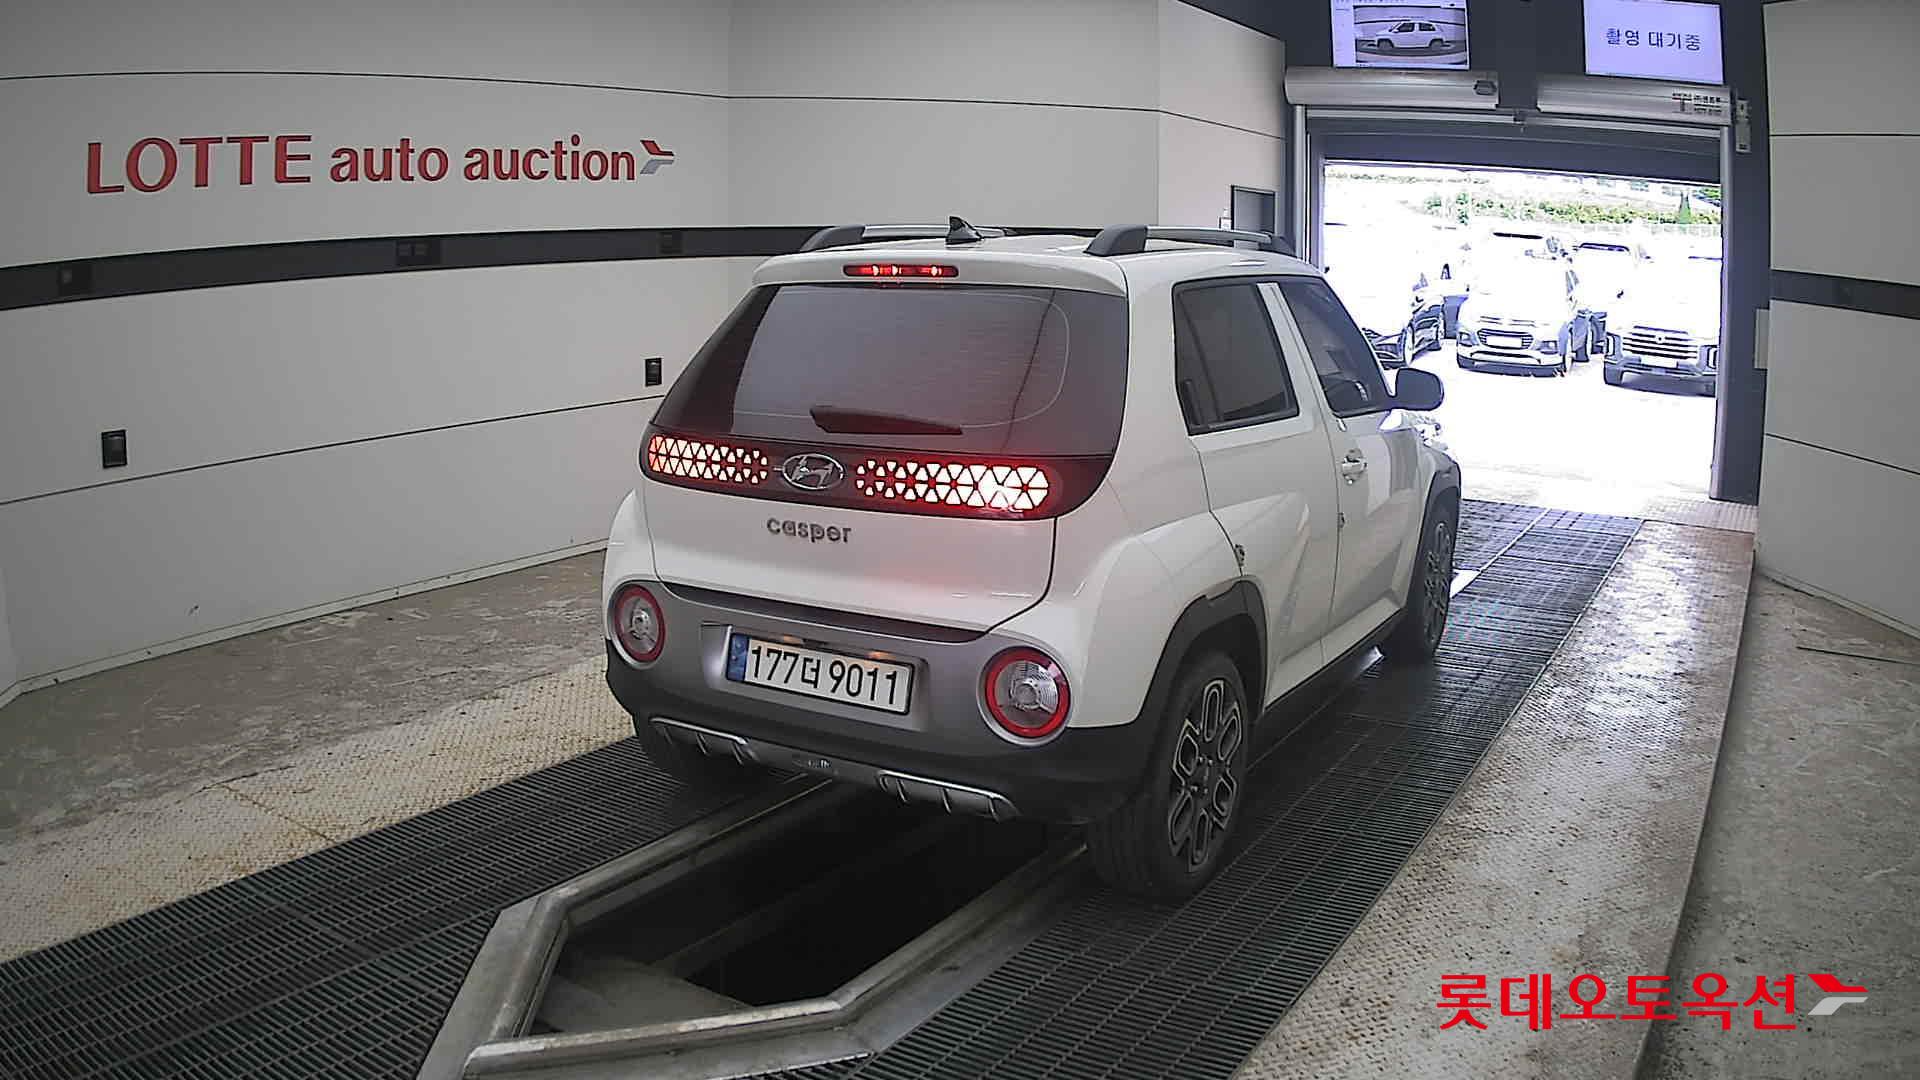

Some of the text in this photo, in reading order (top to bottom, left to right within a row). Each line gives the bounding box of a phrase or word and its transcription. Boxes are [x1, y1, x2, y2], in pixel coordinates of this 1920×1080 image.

[1606, 28, 1701, 51] 촬영 대기중
[86, 134, 637, 195] LOTTE auto auction
[766, 517, 852, 543] casper
[829, 660, 898, 705] 9011
